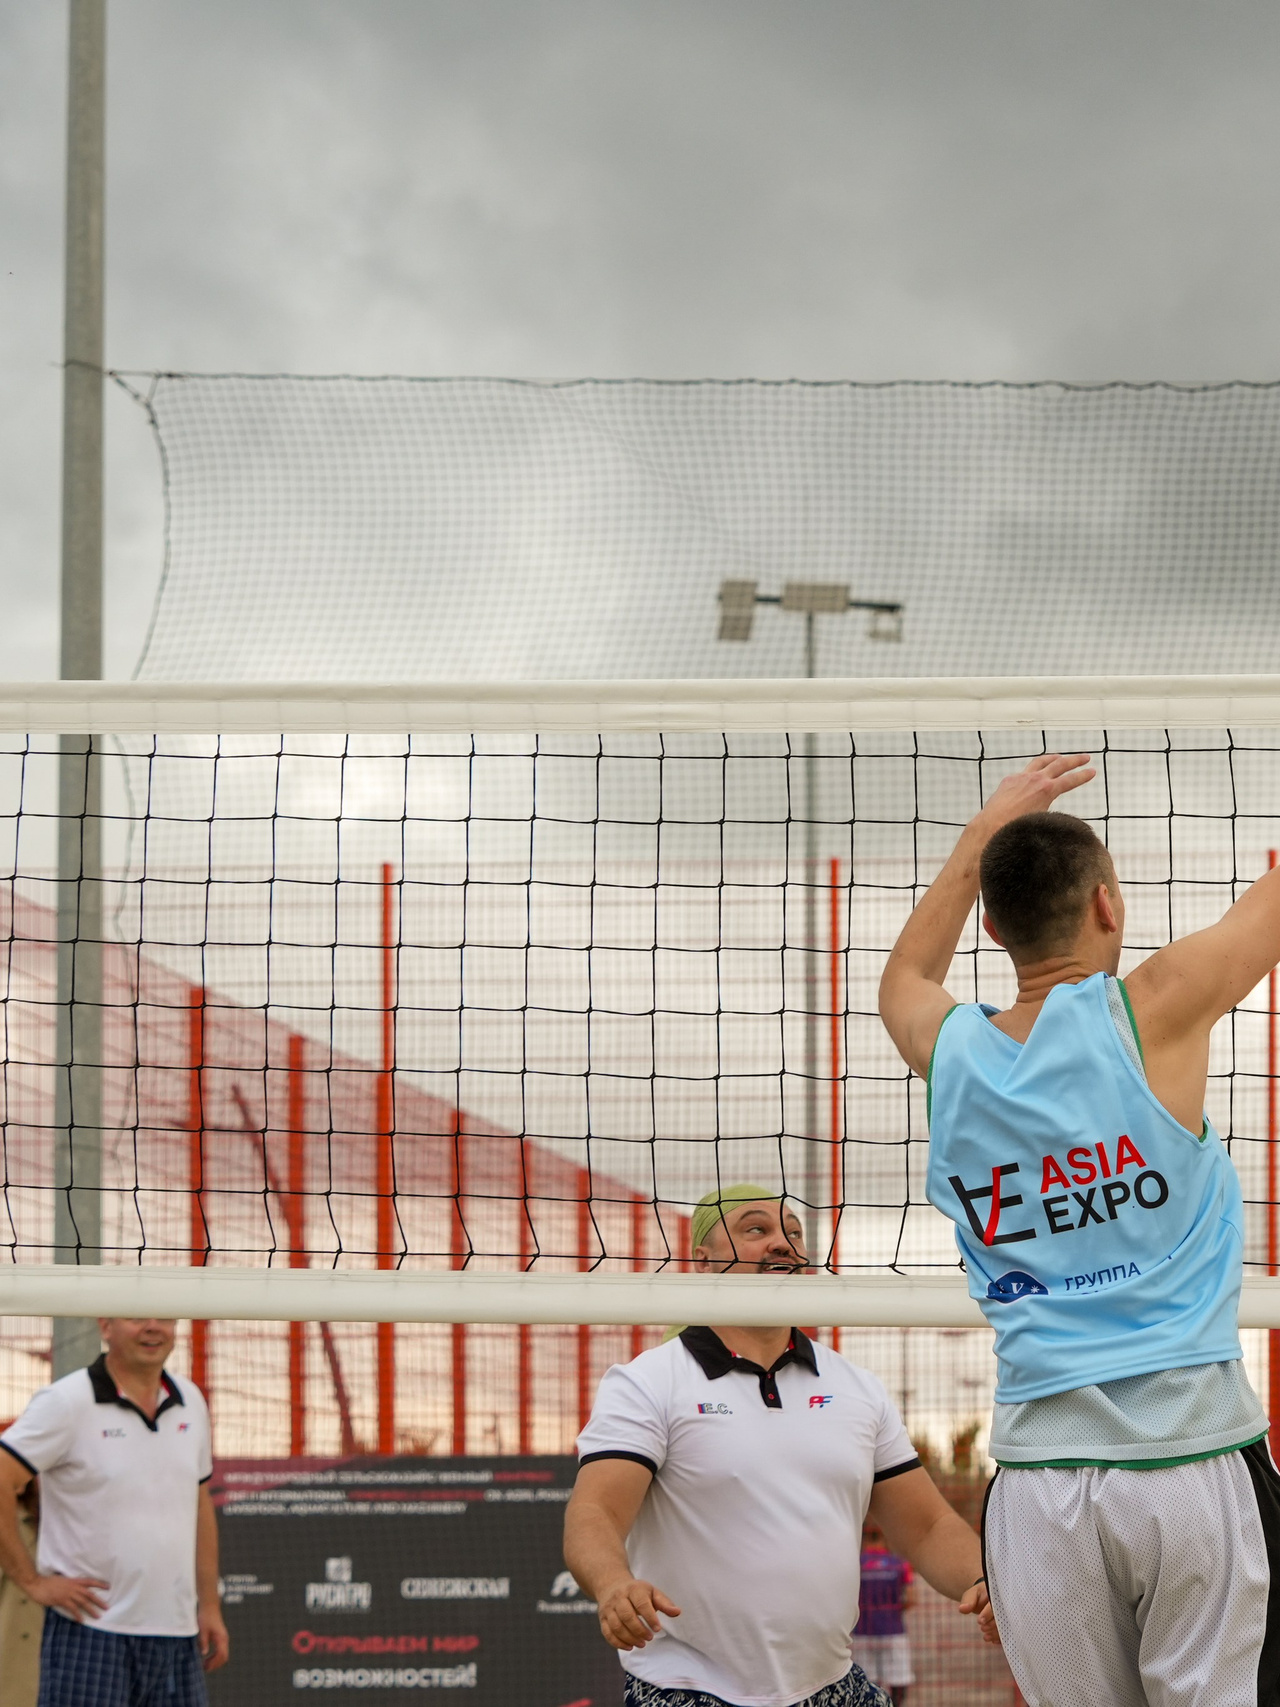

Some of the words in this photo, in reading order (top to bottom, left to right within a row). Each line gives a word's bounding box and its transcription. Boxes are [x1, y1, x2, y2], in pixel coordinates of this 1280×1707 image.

[1040, 1134, 1148, 1194] ASIA
[1042, 1169, 1169, 1234] EXPO
[1064, 1261, 1142, 1291] ГРУППА
